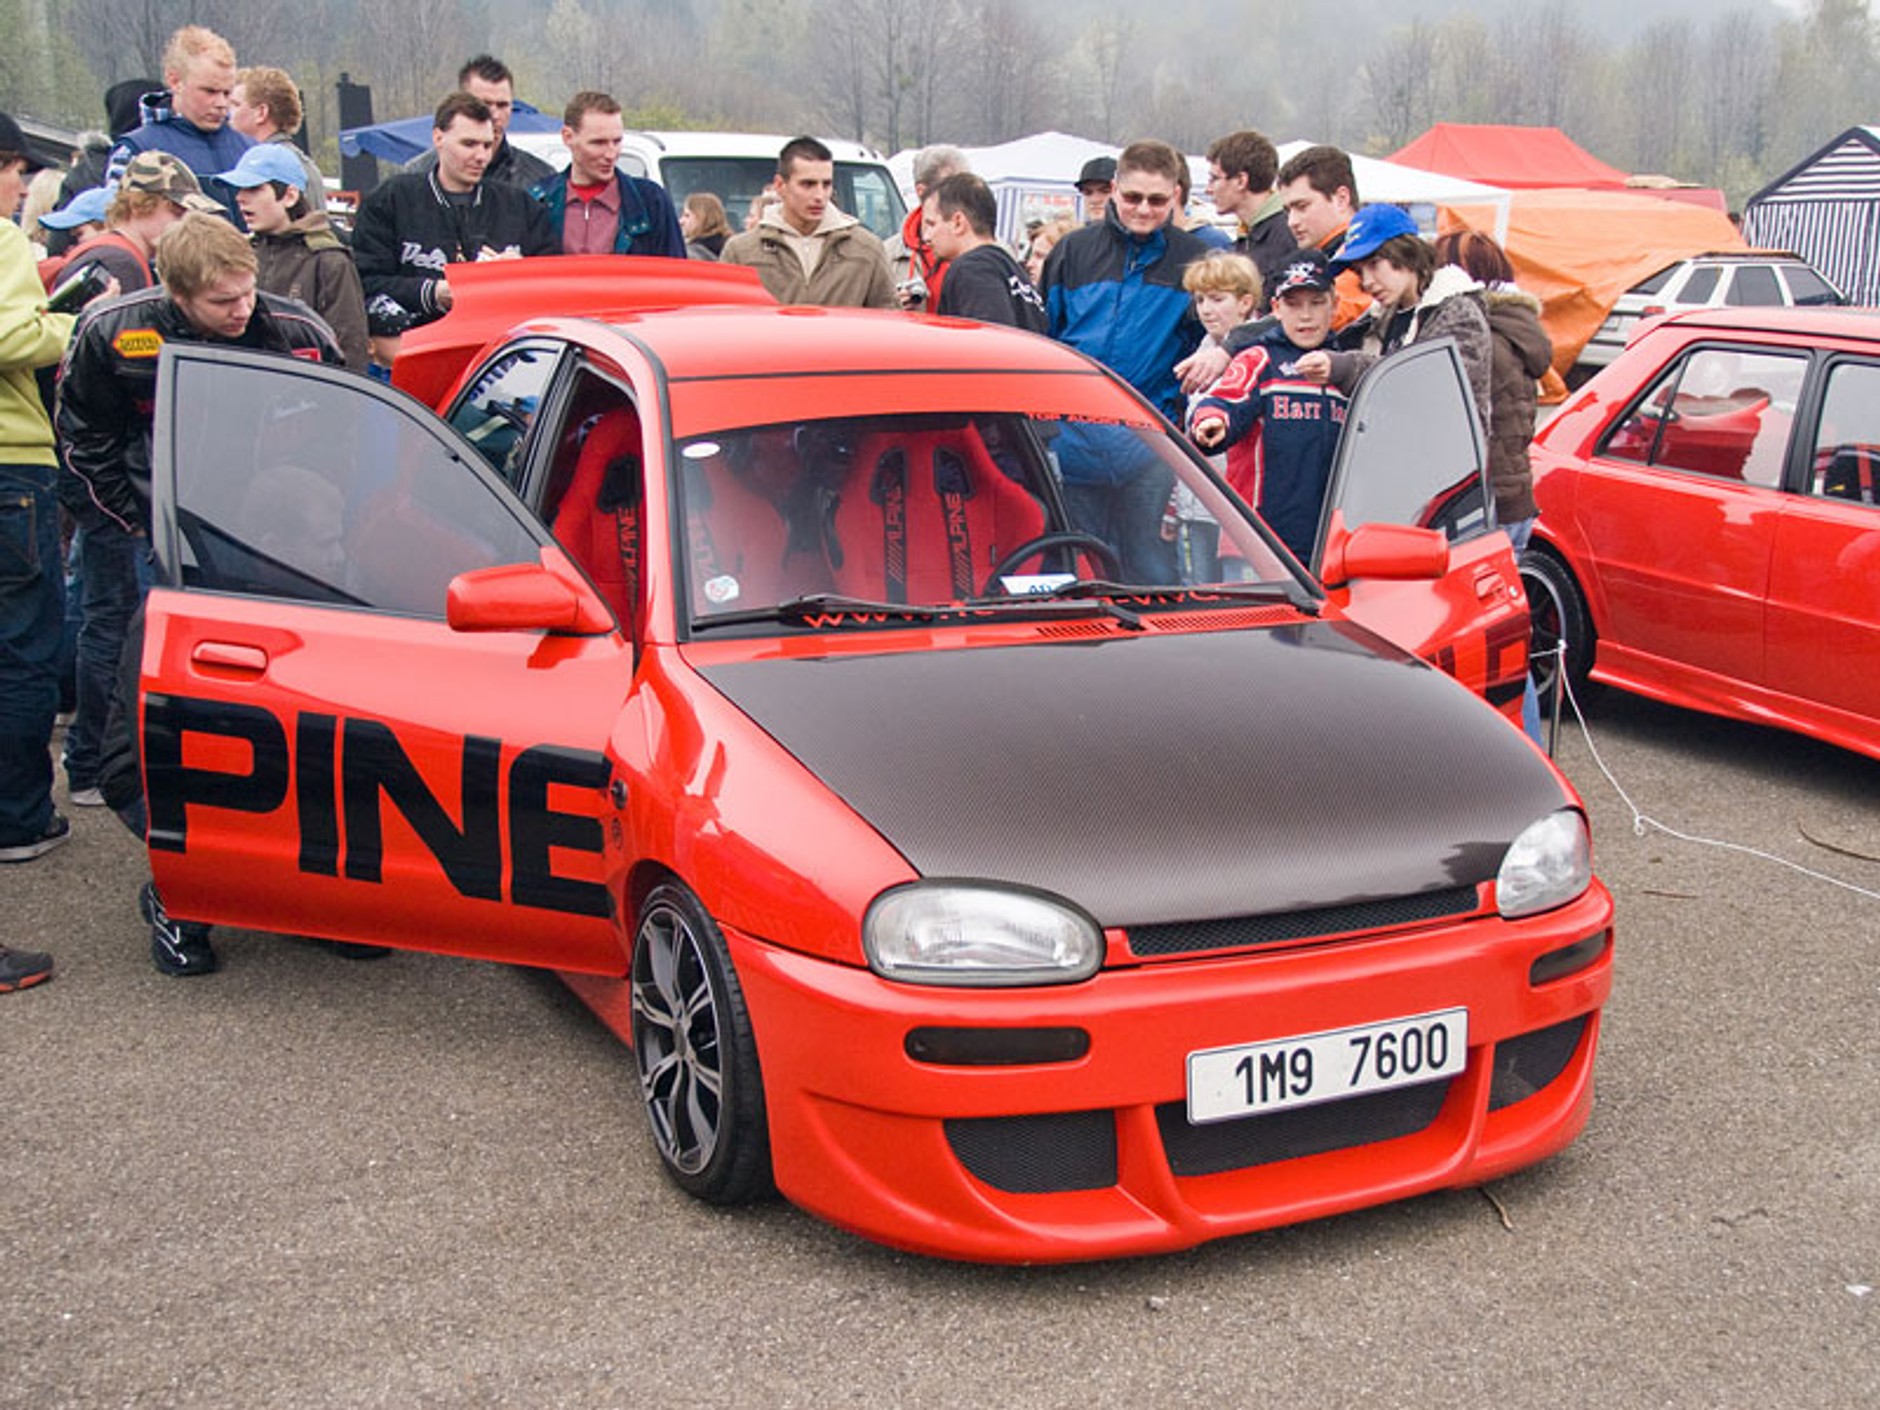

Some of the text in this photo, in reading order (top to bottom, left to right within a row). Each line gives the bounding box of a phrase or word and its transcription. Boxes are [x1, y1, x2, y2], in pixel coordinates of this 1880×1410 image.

[144, 692, 613, 918] PINE
[1236, 1022, 1447, 1105] 1M9 7600
